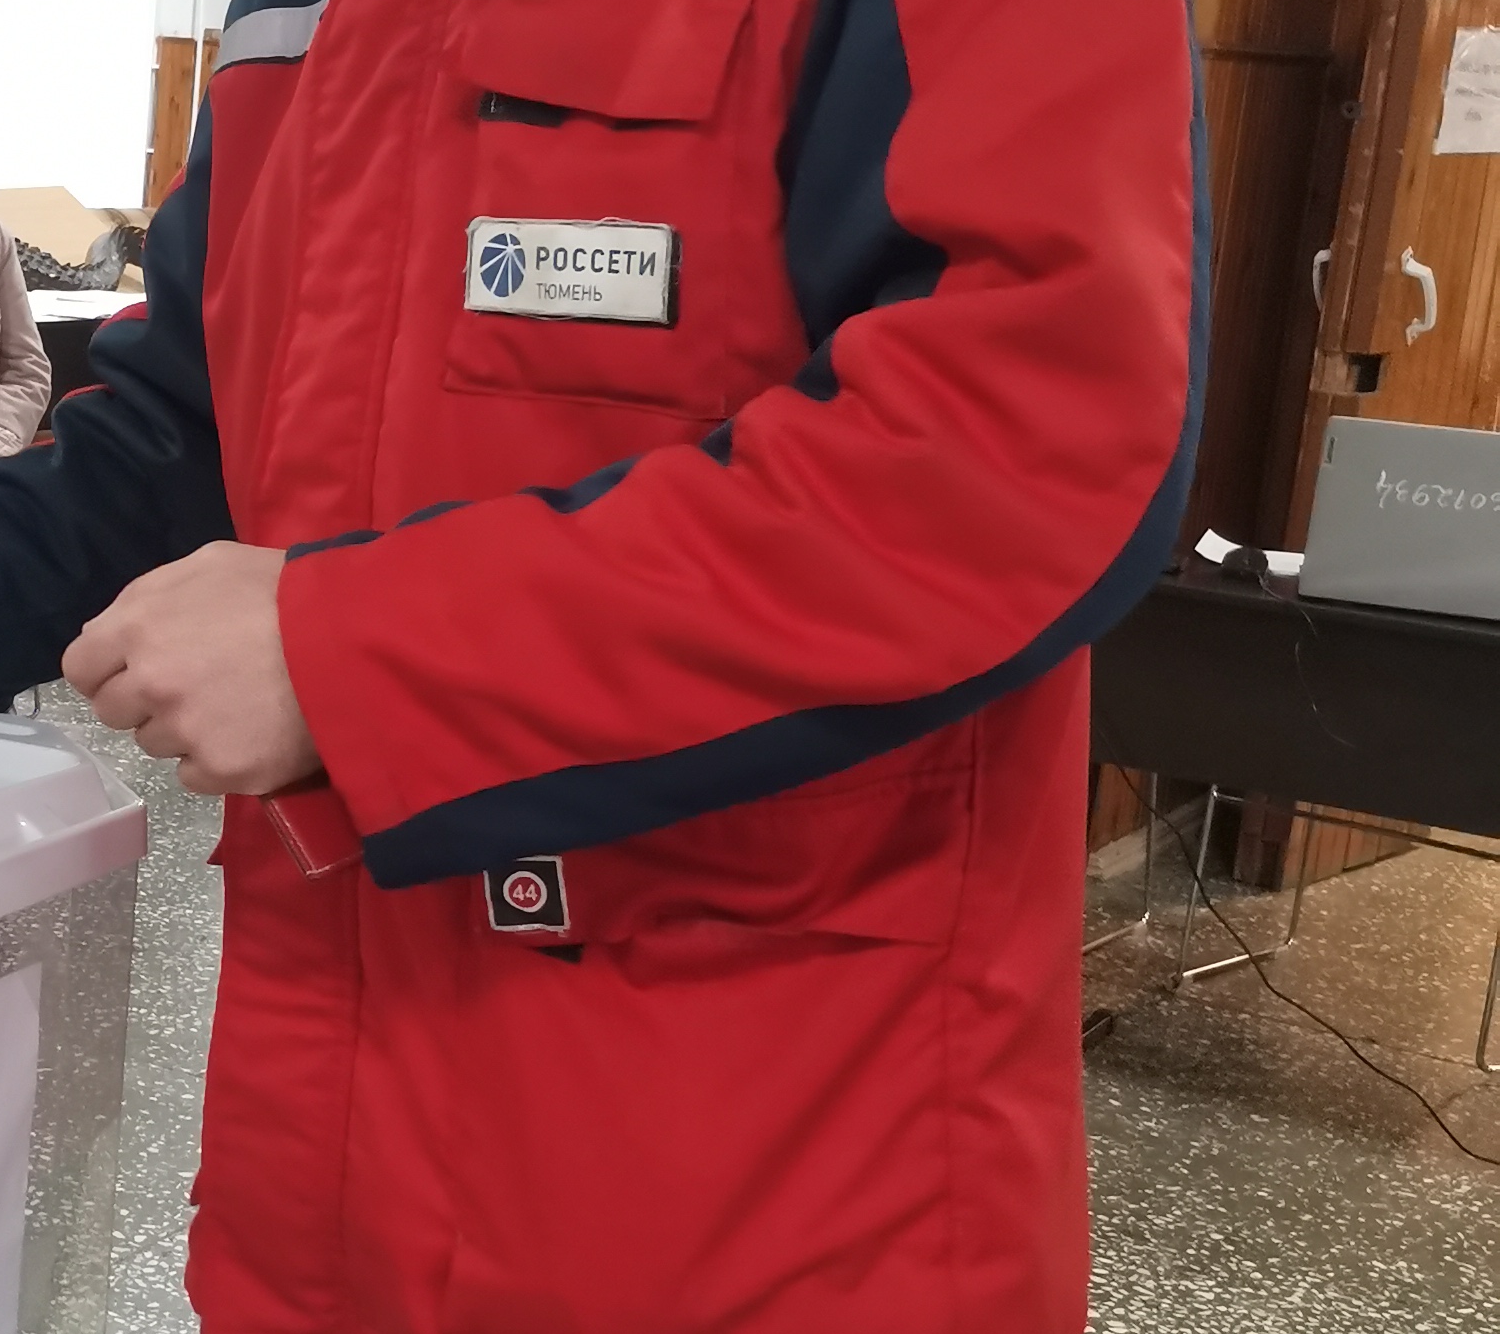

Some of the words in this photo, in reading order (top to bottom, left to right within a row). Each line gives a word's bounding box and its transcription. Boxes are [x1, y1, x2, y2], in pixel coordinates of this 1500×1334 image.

[536, 246, 657, 277] РОССЕТИ
[536, 282, 604, 303] ТЮМЕНЬ
[512, 884, 538, 901] 44
